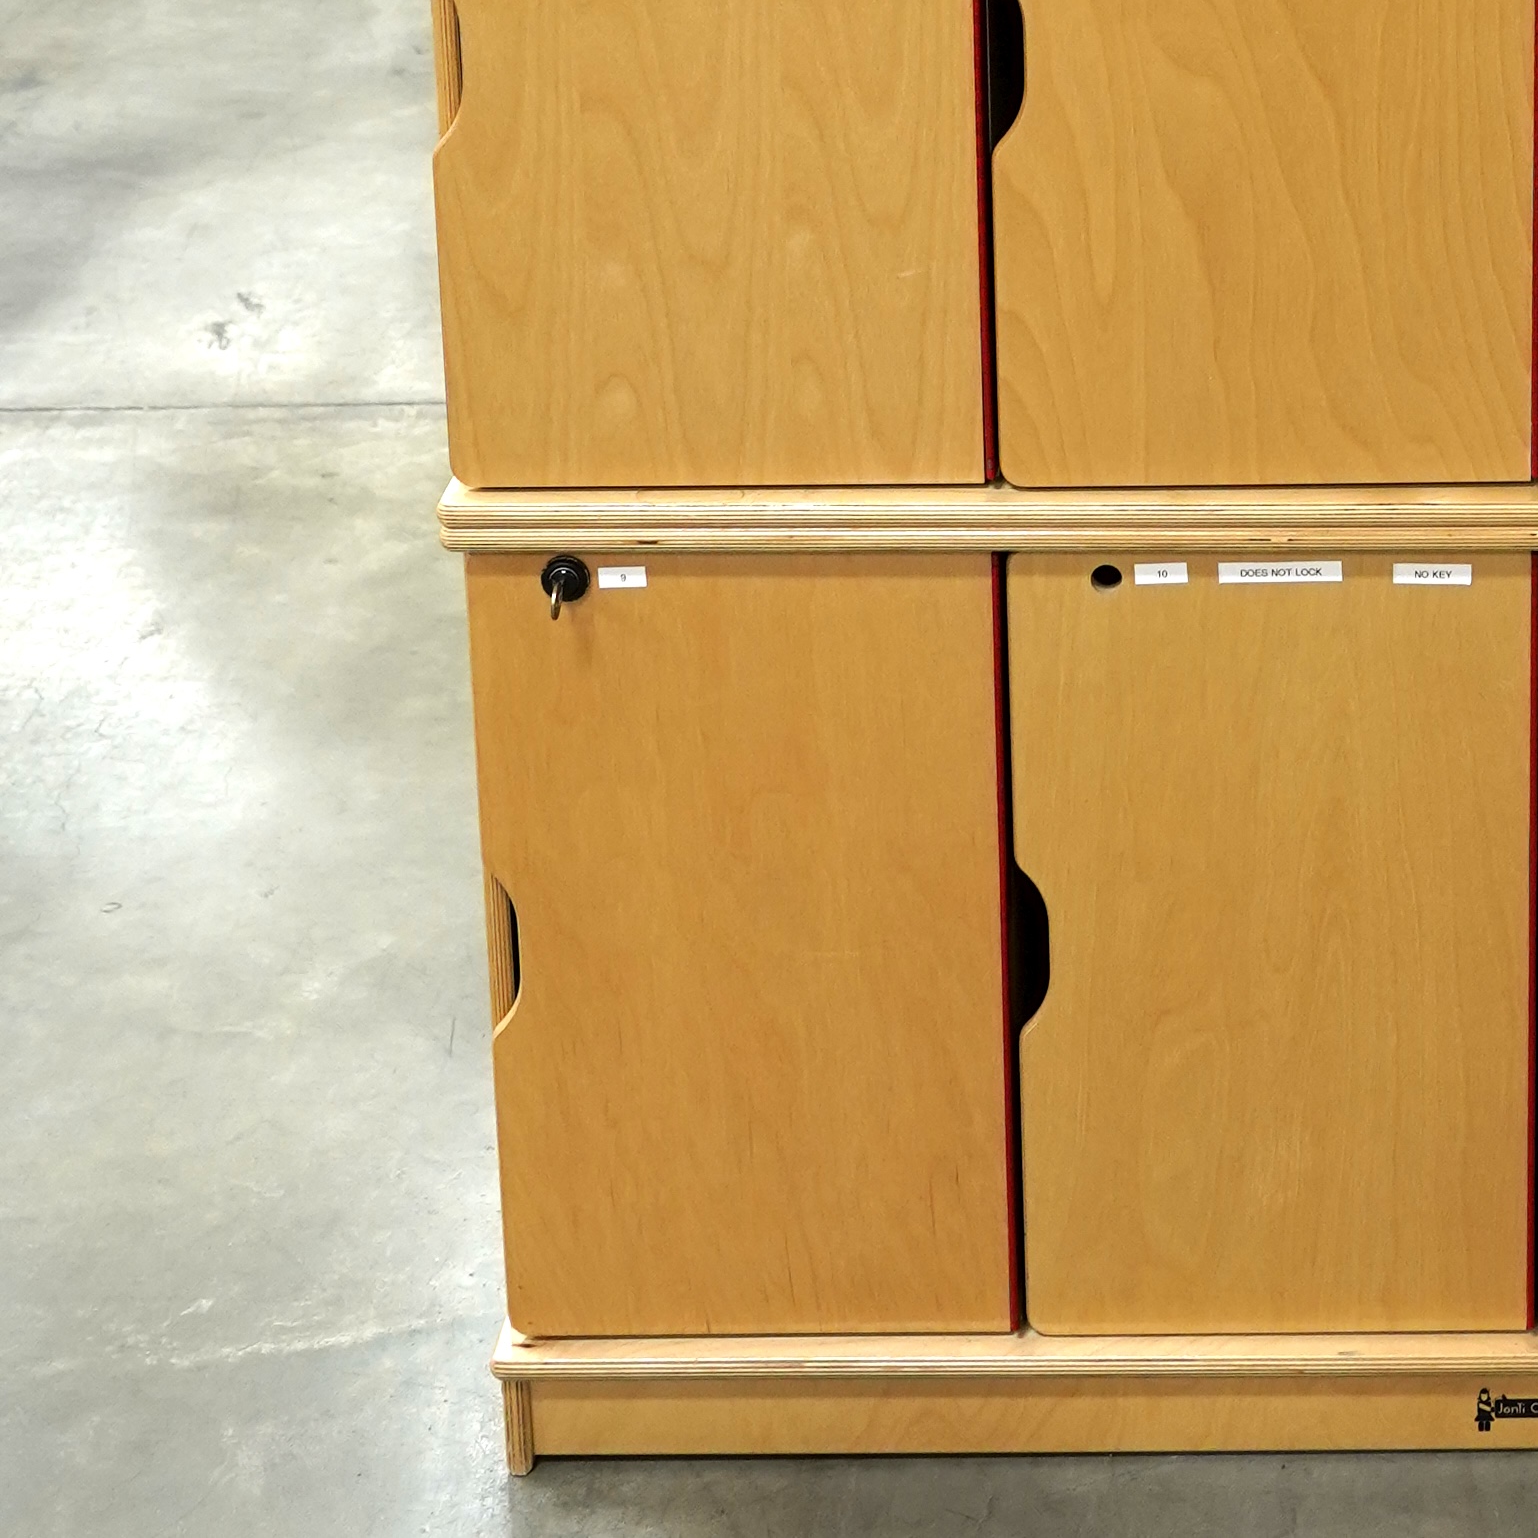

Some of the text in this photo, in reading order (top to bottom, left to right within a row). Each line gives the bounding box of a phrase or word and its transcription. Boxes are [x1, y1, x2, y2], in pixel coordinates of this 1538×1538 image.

[1158, 569, 1169, 579] 10
[1240, 567, 1322, 578] DOES NOT LOCK
[1414, 569, 1452, 579] NO KEY
[620, 573, 627, 583] 9
[1498, 1402, 1526, 1414] Jonti
